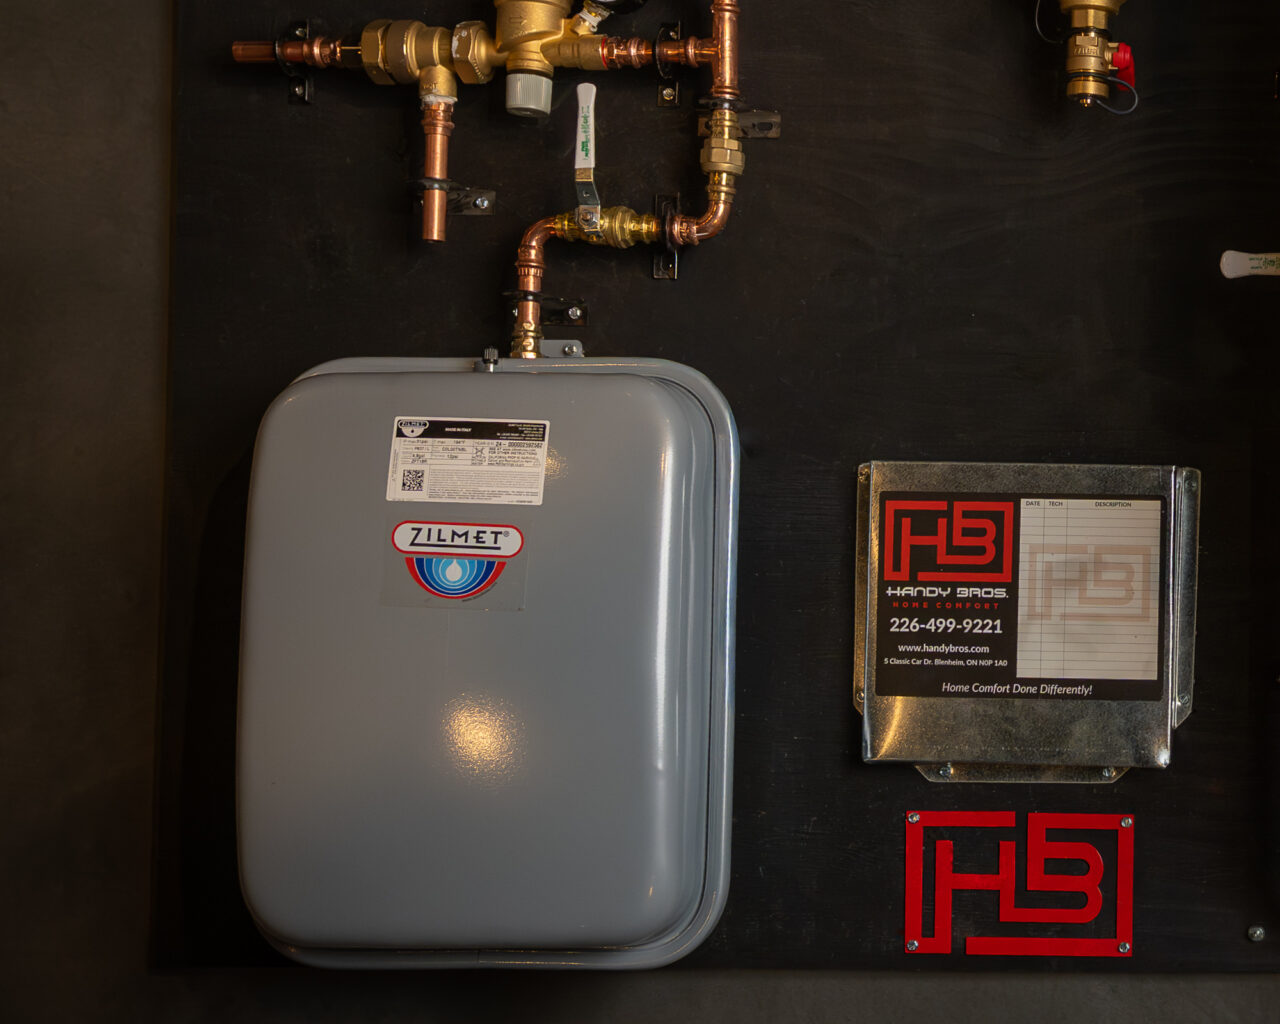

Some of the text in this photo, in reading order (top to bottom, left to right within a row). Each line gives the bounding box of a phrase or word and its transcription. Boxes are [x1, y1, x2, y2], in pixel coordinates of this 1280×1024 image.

[409, 527, 502, 550] ZILMET
[886, 586, 951, 597] HANDY
[892, 601, 999, 610] HOME COMFORT
[890, 617, 1003, 634] 226-499-9221
[898, 644, 990, 654] www.handybros.com
[923, 658, 934, 666] Dr.
[942, 682, 1093, 697] Home Comfort Done Differently!
